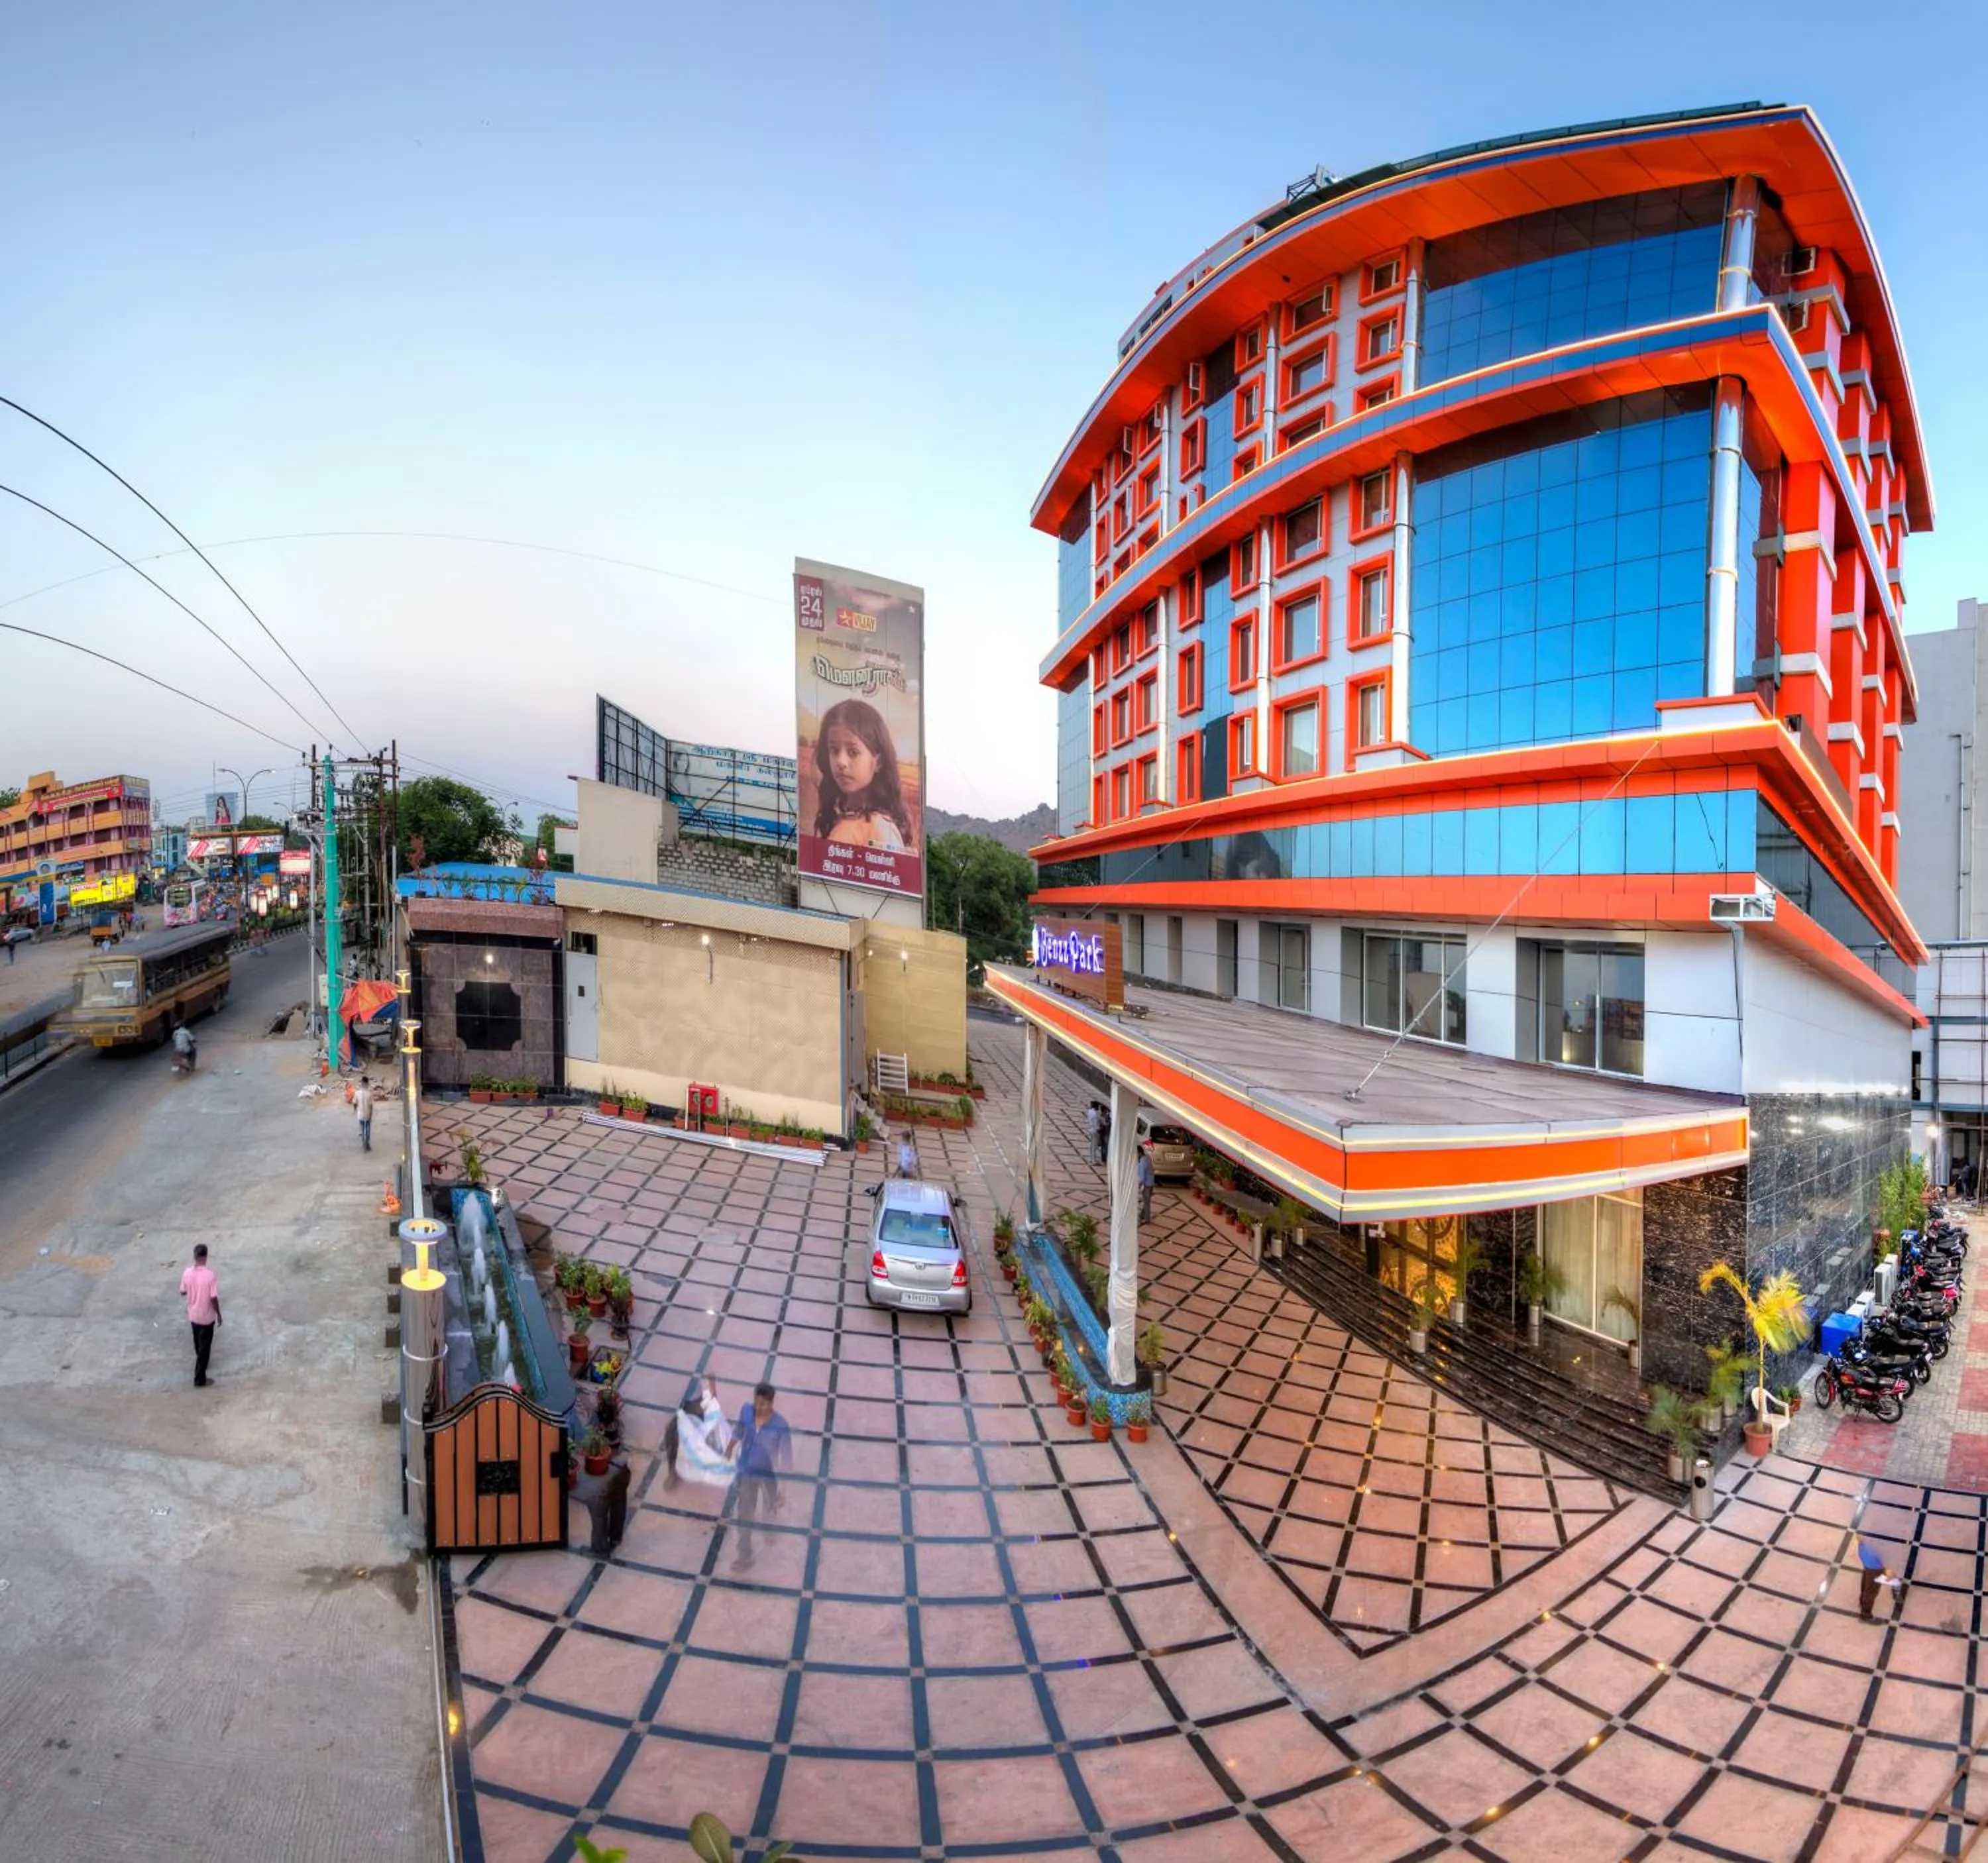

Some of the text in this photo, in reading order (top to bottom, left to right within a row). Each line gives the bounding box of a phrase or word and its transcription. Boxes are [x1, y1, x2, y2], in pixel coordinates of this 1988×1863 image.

[801, 596, 822, 617] 24
[848, 865, 865, 877] 7.30
[1070, 931, 1105, 973] Park
